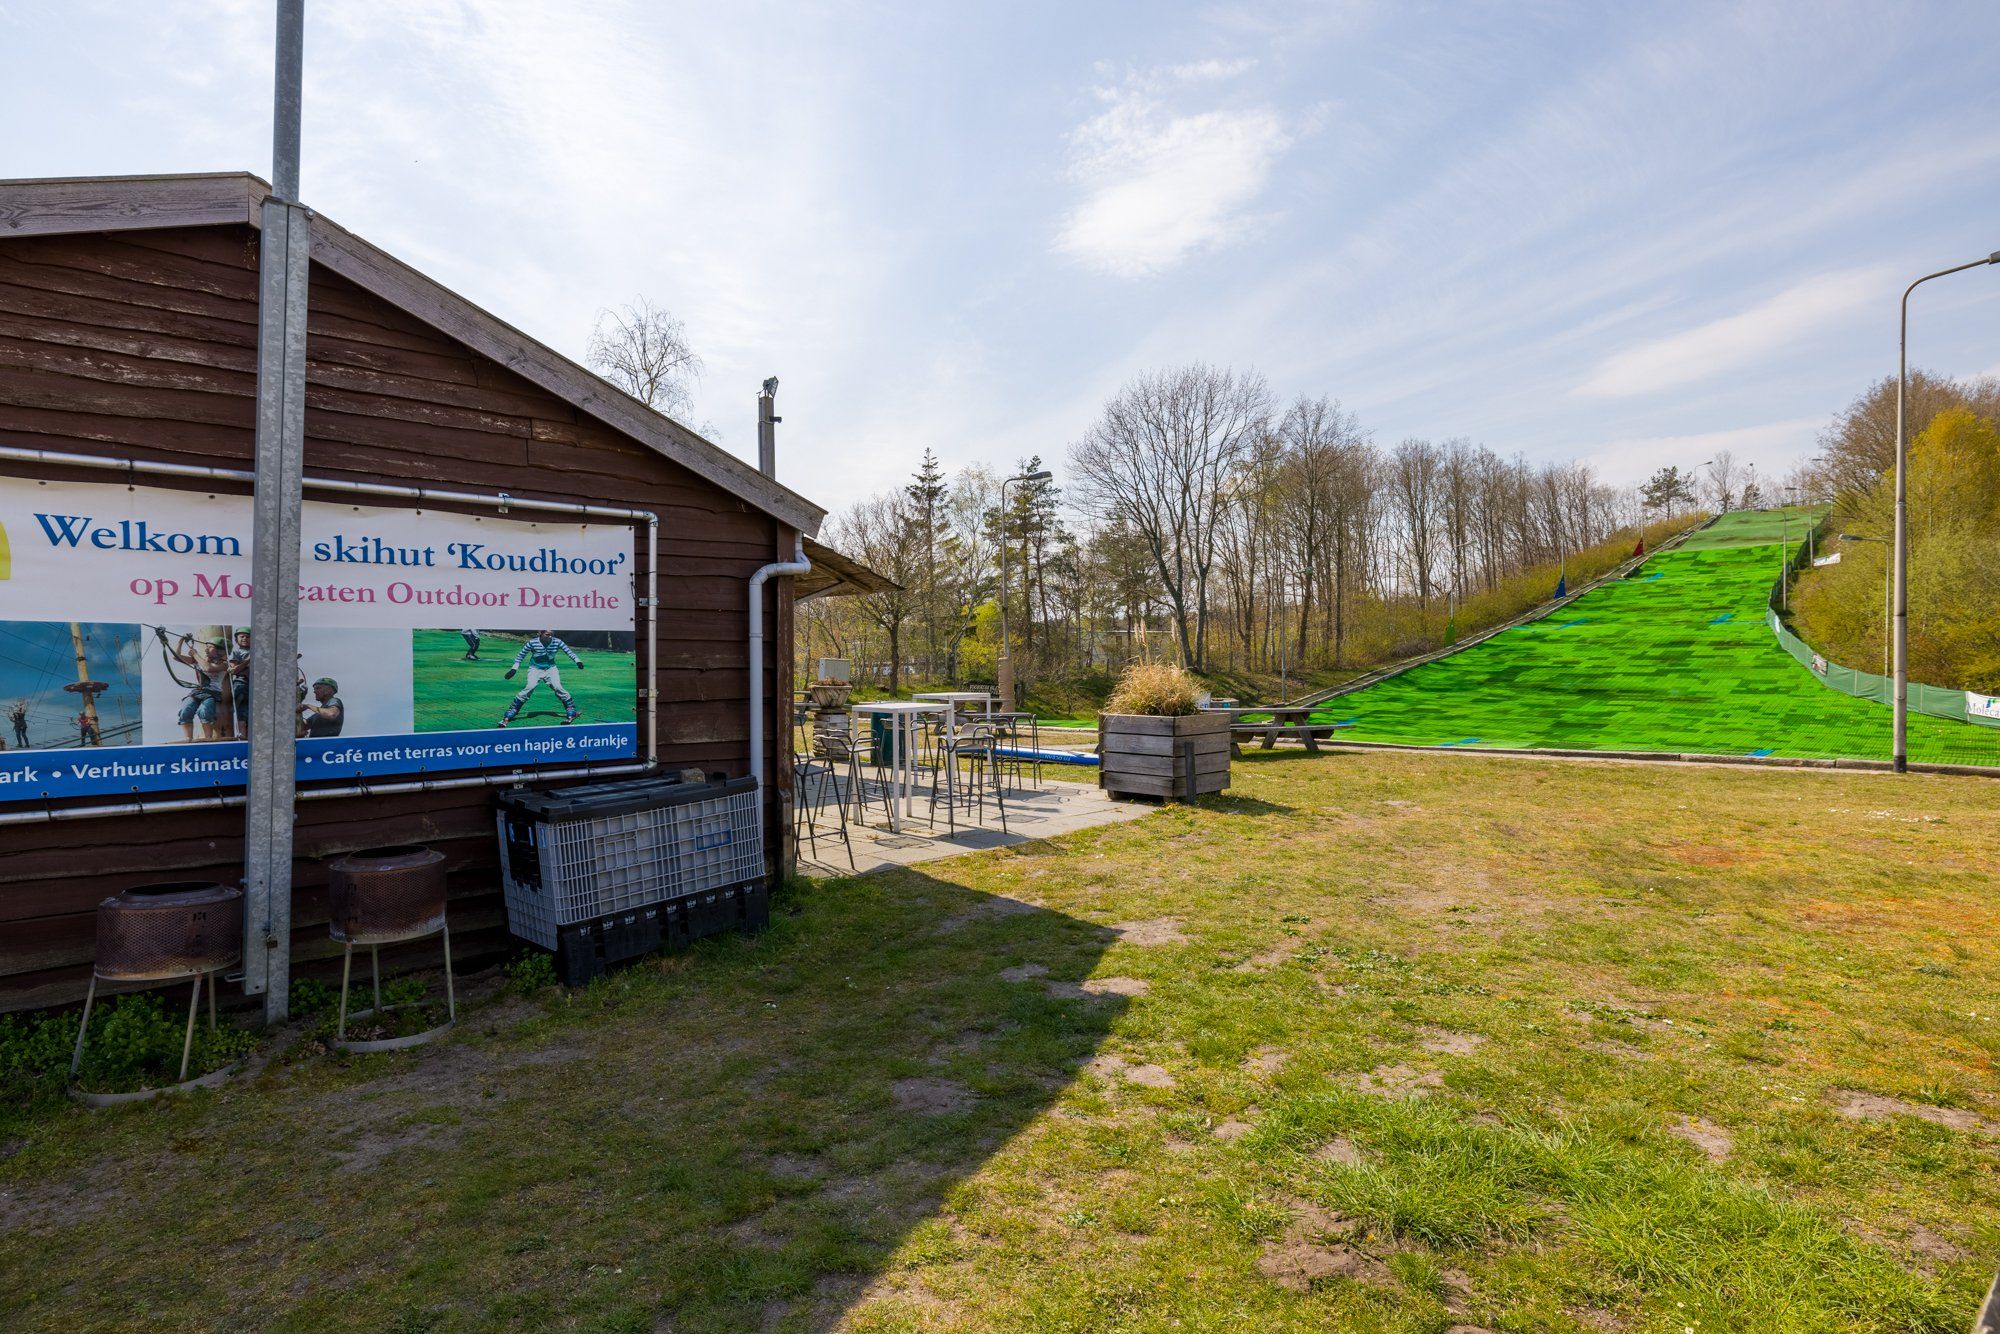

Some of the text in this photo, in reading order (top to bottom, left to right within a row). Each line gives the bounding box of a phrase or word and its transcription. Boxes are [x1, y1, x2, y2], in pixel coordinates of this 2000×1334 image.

[33, 513, 242, 557] Welkom
[313, 534, 436, 568] skihut
[129, 578, 180, 605] op
[386, 582, 509, 607] Outdoor
[518, 586, 620, 609] Drenthe
[322, 734, 628, 764] Café met terras voor een hapje & drankje
[0, 766, 38, 783] ark
[71, 757, 249, 779] Verhuur skimate
